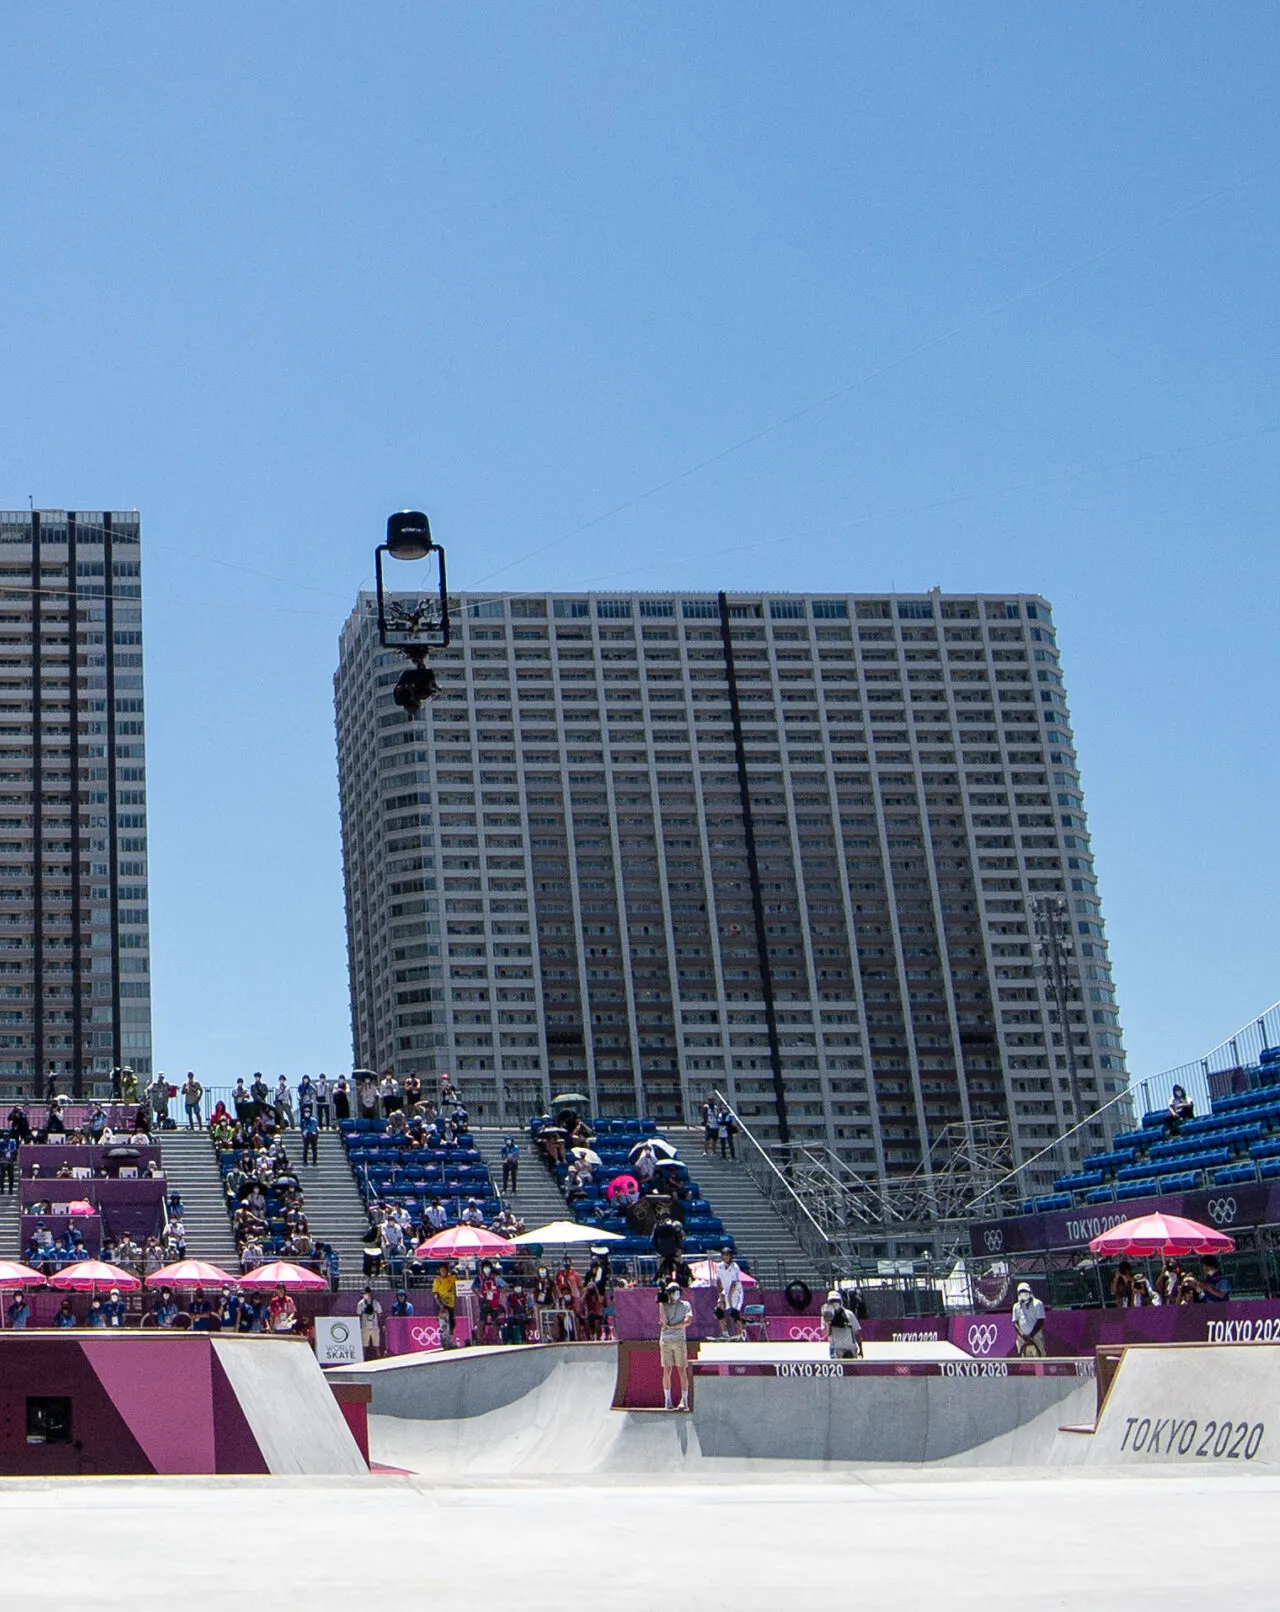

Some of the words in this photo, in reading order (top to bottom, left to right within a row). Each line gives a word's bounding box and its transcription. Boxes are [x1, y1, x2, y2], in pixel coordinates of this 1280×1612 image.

[1066, 1217, 1101, 1241] TOKYO
[1207, 1319, 1252, 1343] TOKYO
[1254, 1318, 1280, 1341] 202
[326, 1351, 356, 1359] SKATE
[774, 1363, 813, 1377] TOKYO
[814, 1363, 844, 1377] 2020
[938, 1363, 979, 1376] TOKYO
[980, 1363, 1008, 1377] 2020
[1120, 1417, 1197, 1455] TOKYO
[1195, 1420, 1265, 1460] 2020
